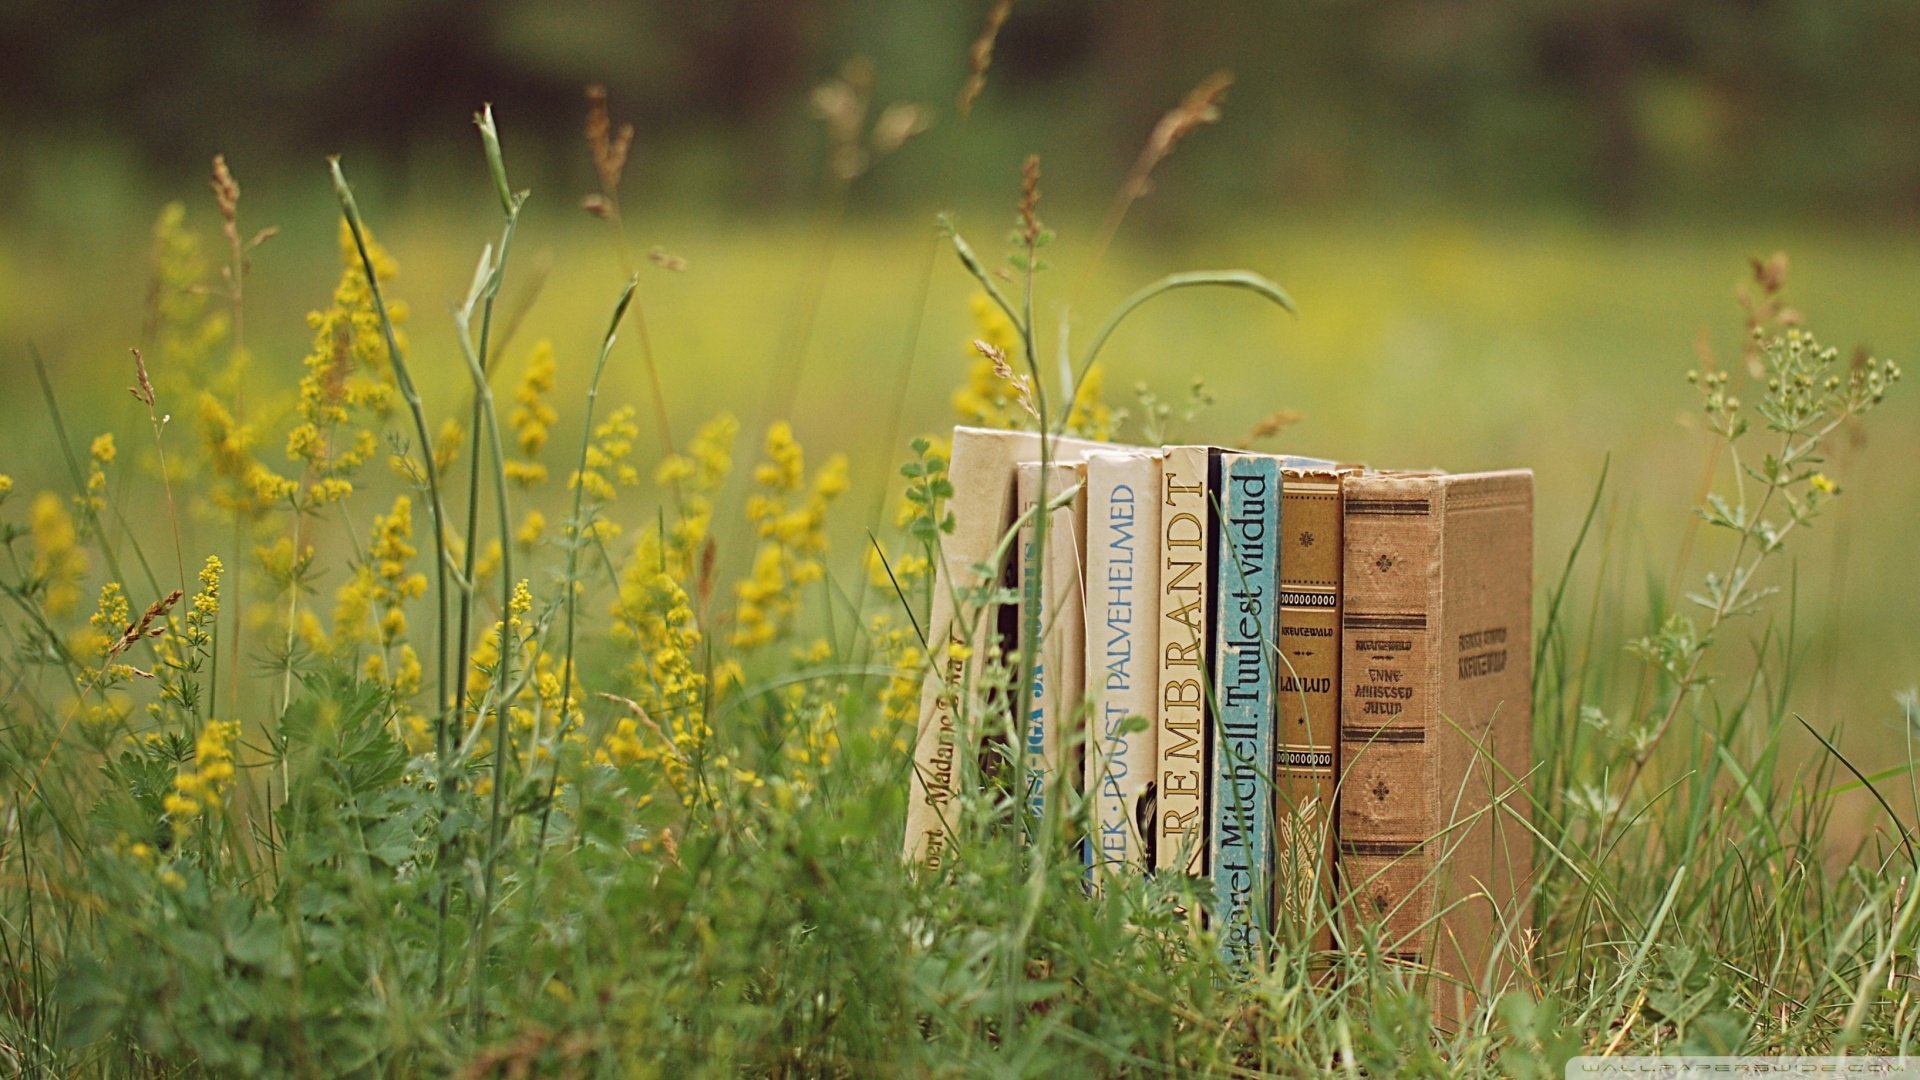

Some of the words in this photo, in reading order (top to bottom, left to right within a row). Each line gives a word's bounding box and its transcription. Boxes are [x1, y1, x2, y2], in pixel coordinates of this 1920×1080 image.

[1230, 474, 1266, 577] viidud
[1106, 485, 1134, 690] PALVEHELMED
[1028, 663, 1044, 698] JA
[1163, 473, 1203, 838] REMBRANDT
[1226, 586, 1263, 707] Tuulest
[1280, 676, 1331, 693] LAULUD
[1104, 702, 1130, 797] PUUST
